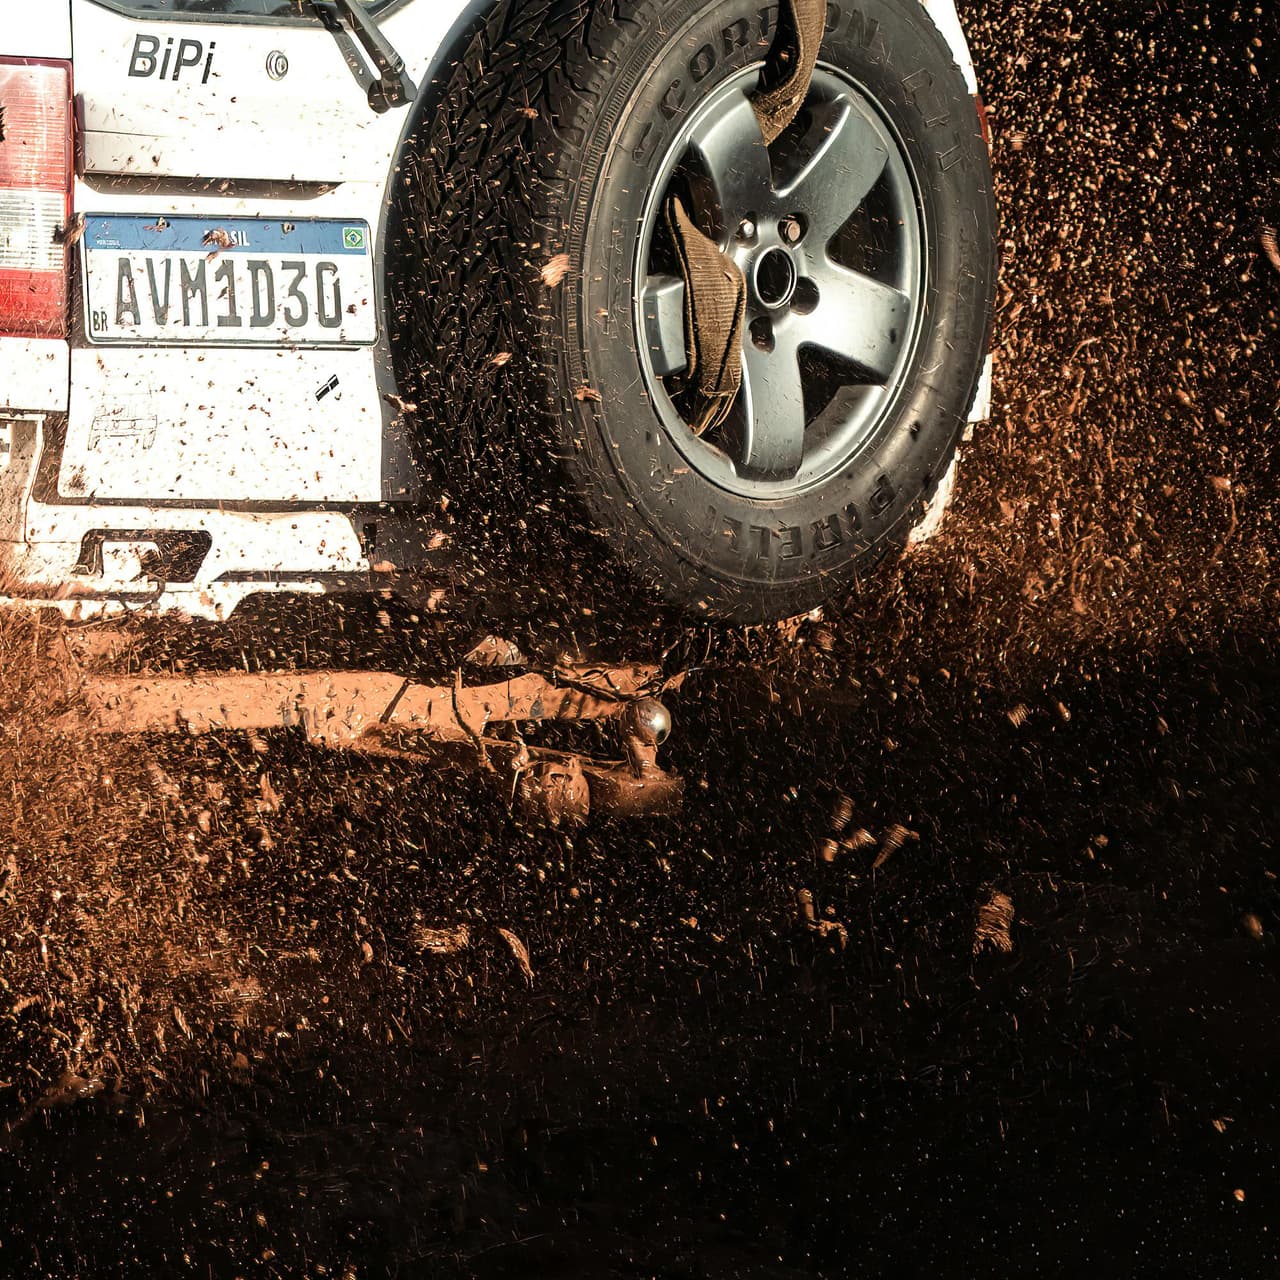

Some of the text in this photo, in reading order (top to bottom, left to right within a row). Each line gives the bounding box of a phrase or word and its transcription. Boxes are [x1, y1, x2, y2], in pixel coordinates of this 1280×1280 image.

[128, 33, 216, 85] BiPi
[631, 1, 880, 169] SCORPON
[92, 310, 109, 332] BR
[114, 257, 343, 329] AVM1D30
